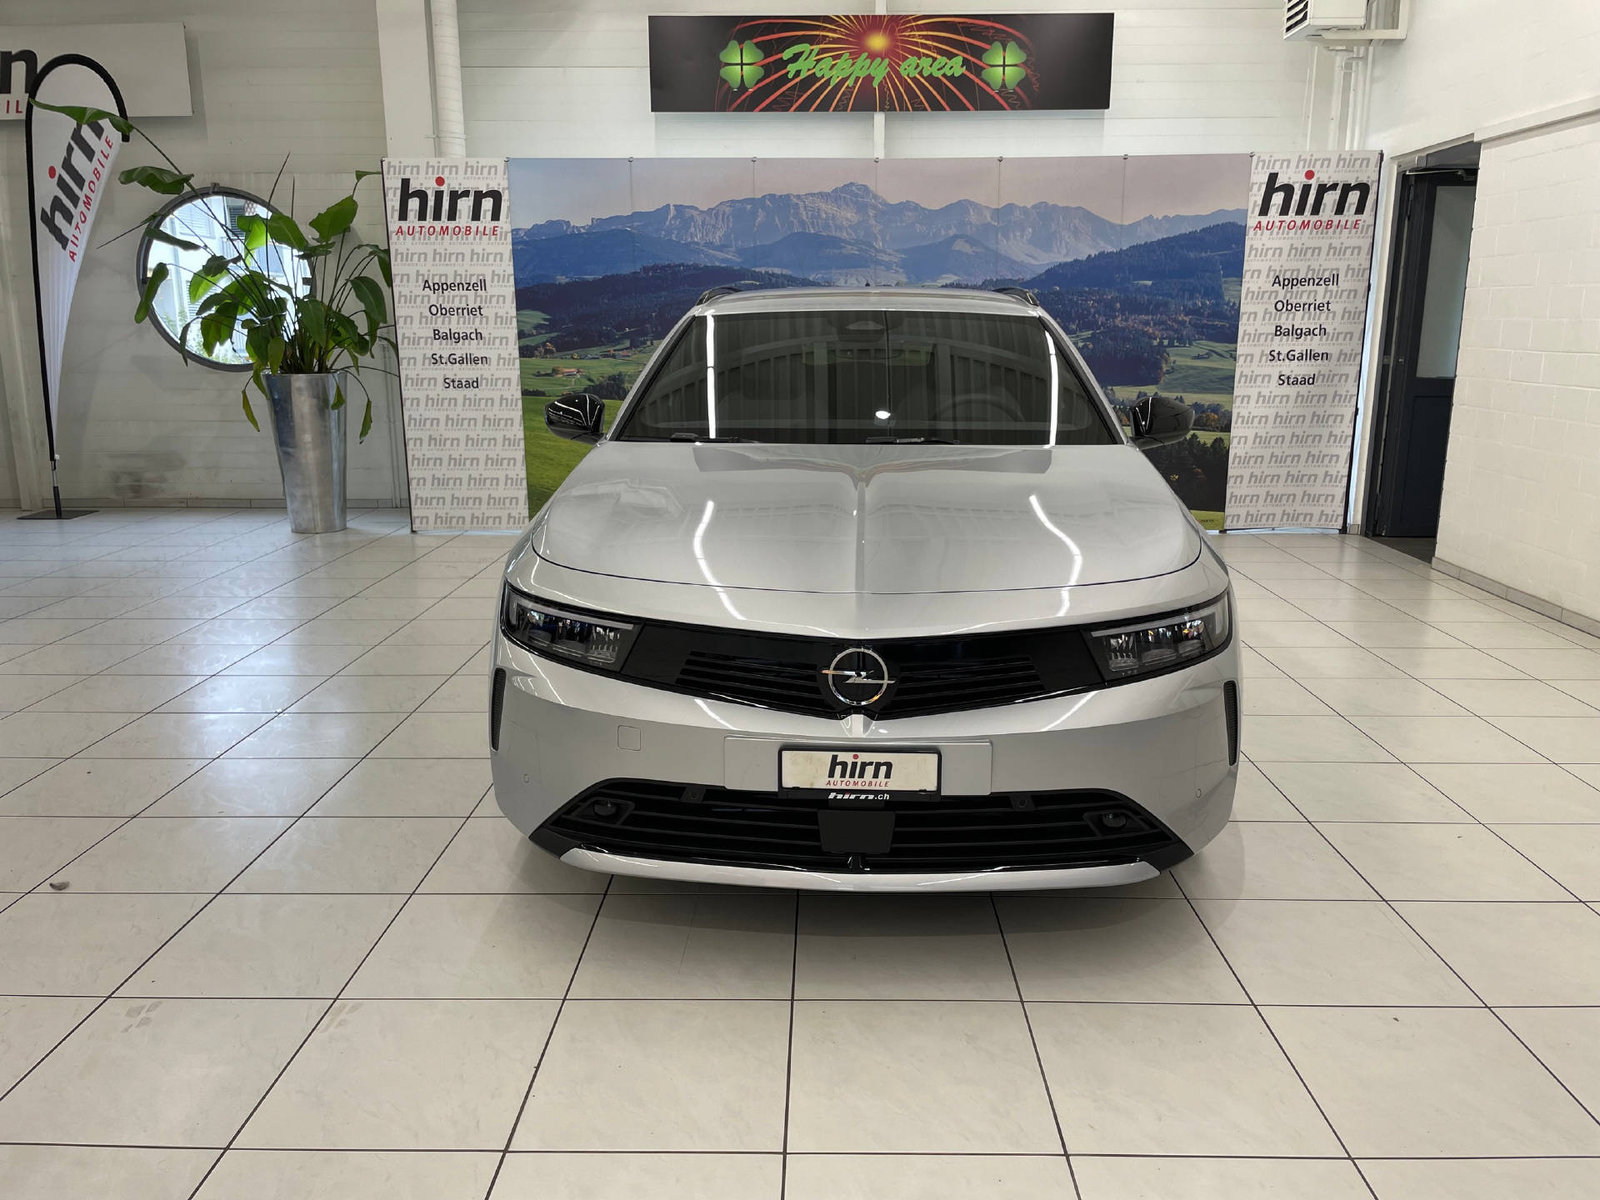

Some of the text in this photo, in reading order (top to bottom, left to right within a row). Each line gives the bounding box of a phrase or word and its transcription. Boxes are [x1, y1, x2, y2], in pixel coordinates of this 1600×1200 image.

[783, 43, 966, 87] Happy area
[398, 176, 503, 221] hirn
[1258, 169, 1370, 216] hirn
[395, 225, 499, 236] AUTOMOBILE
[1253, 219, 1362, 231] AUTOMOBILE
[422, 279, 486, 294] Appenzell
[1272, 274, 1339, 289] Appenzell
[429, 304, 483, 316] Oberriet
[1274, 299, 1331, 312] Oberriet
[433, 329, 483, 343] Balgach
[1275, 324, 1326, 339] Balgach
[431, 353, 488, 365] St.Gallen
[1269, 349, 1328, 362] St.Gallen
[444, 377, 479, 388] Staad
[1278, 374, 1315, 385] Staad
[828, 754, 893, 779] hirn
[826, 779, 890, 787] AUTOMOBILE
[828, 791, 890, 800] hirn.ch
